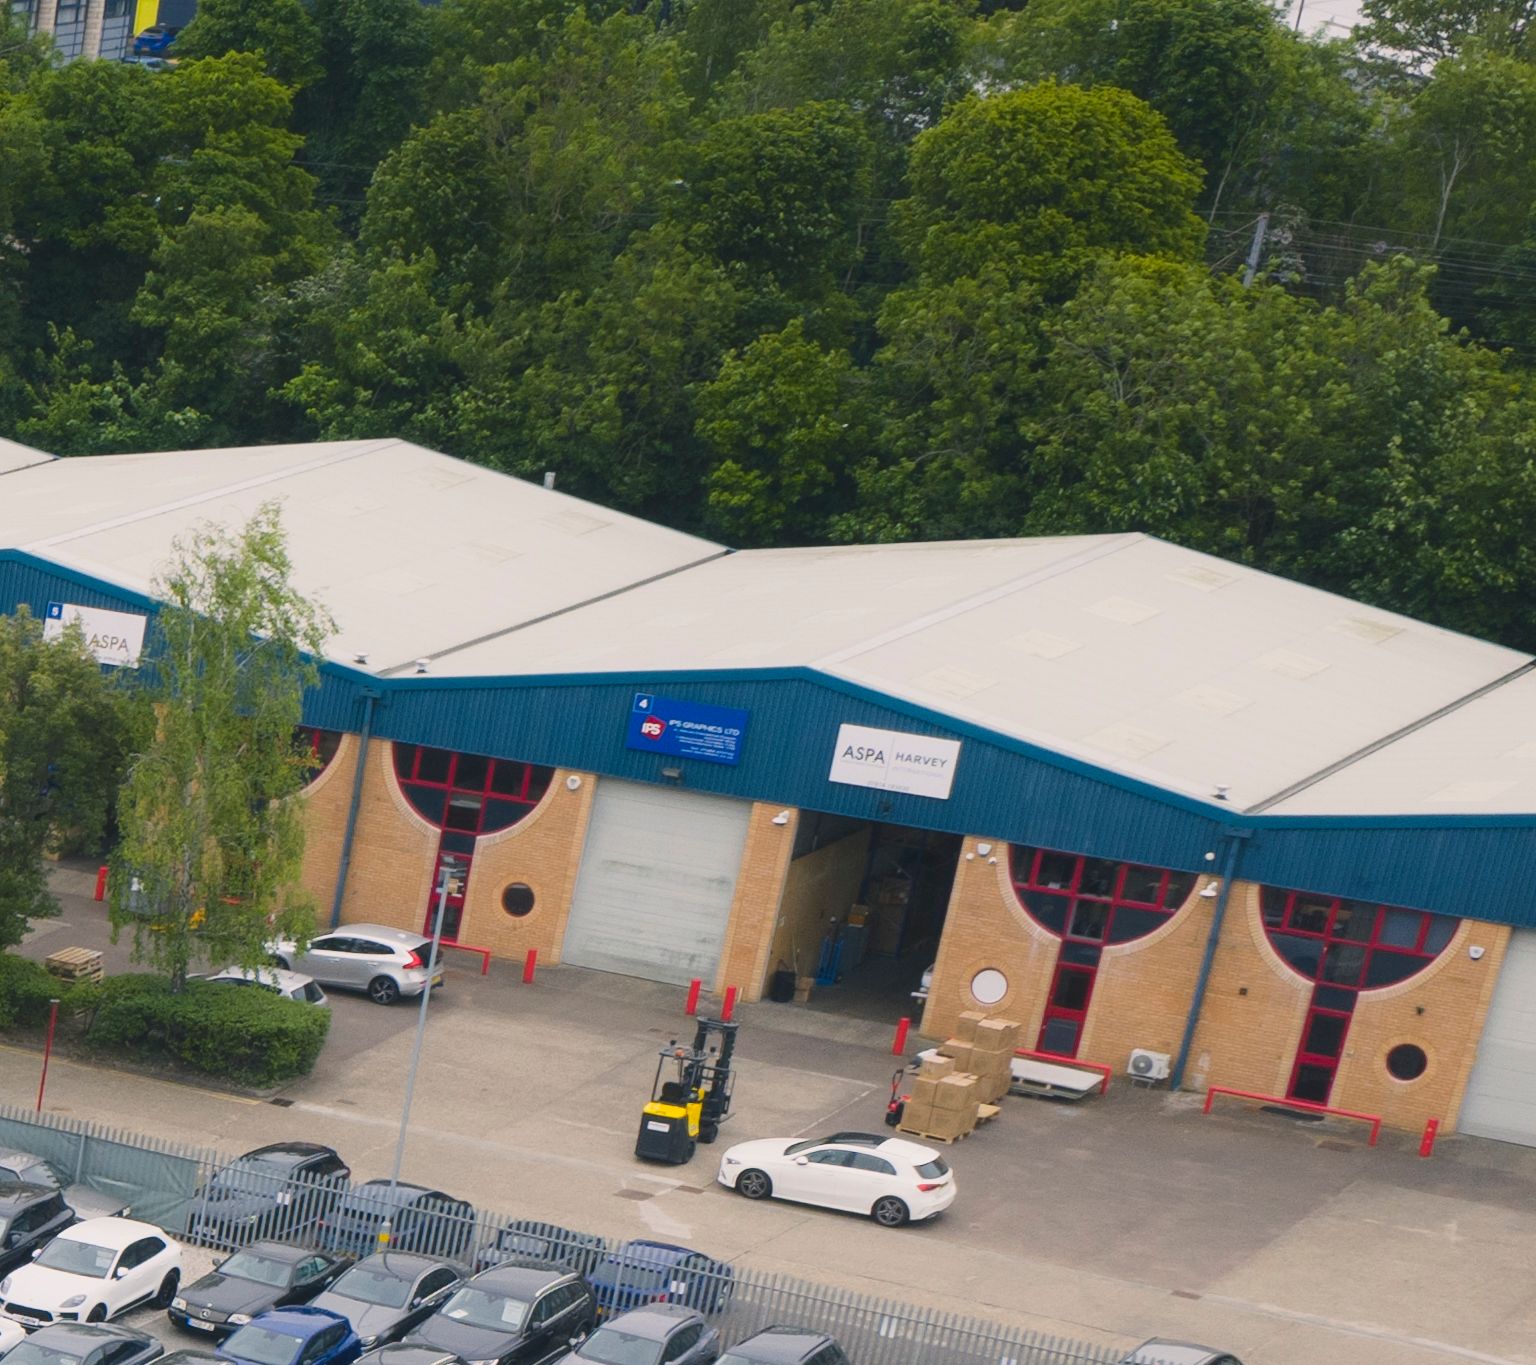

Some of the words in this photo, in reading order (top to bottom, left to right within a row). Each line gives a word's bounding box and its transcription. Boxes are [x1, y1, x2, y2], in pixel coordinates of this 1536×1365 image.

[638, 699, 648, 709] 4
[641, 722, 661, 736] IPS
[682, 721, 723, 734] GRAPHICS
[724, 728, 740, 736] LTD
[842, 745, 885, 764] ASPA
[895, 752, 948, 768] HARVEY
